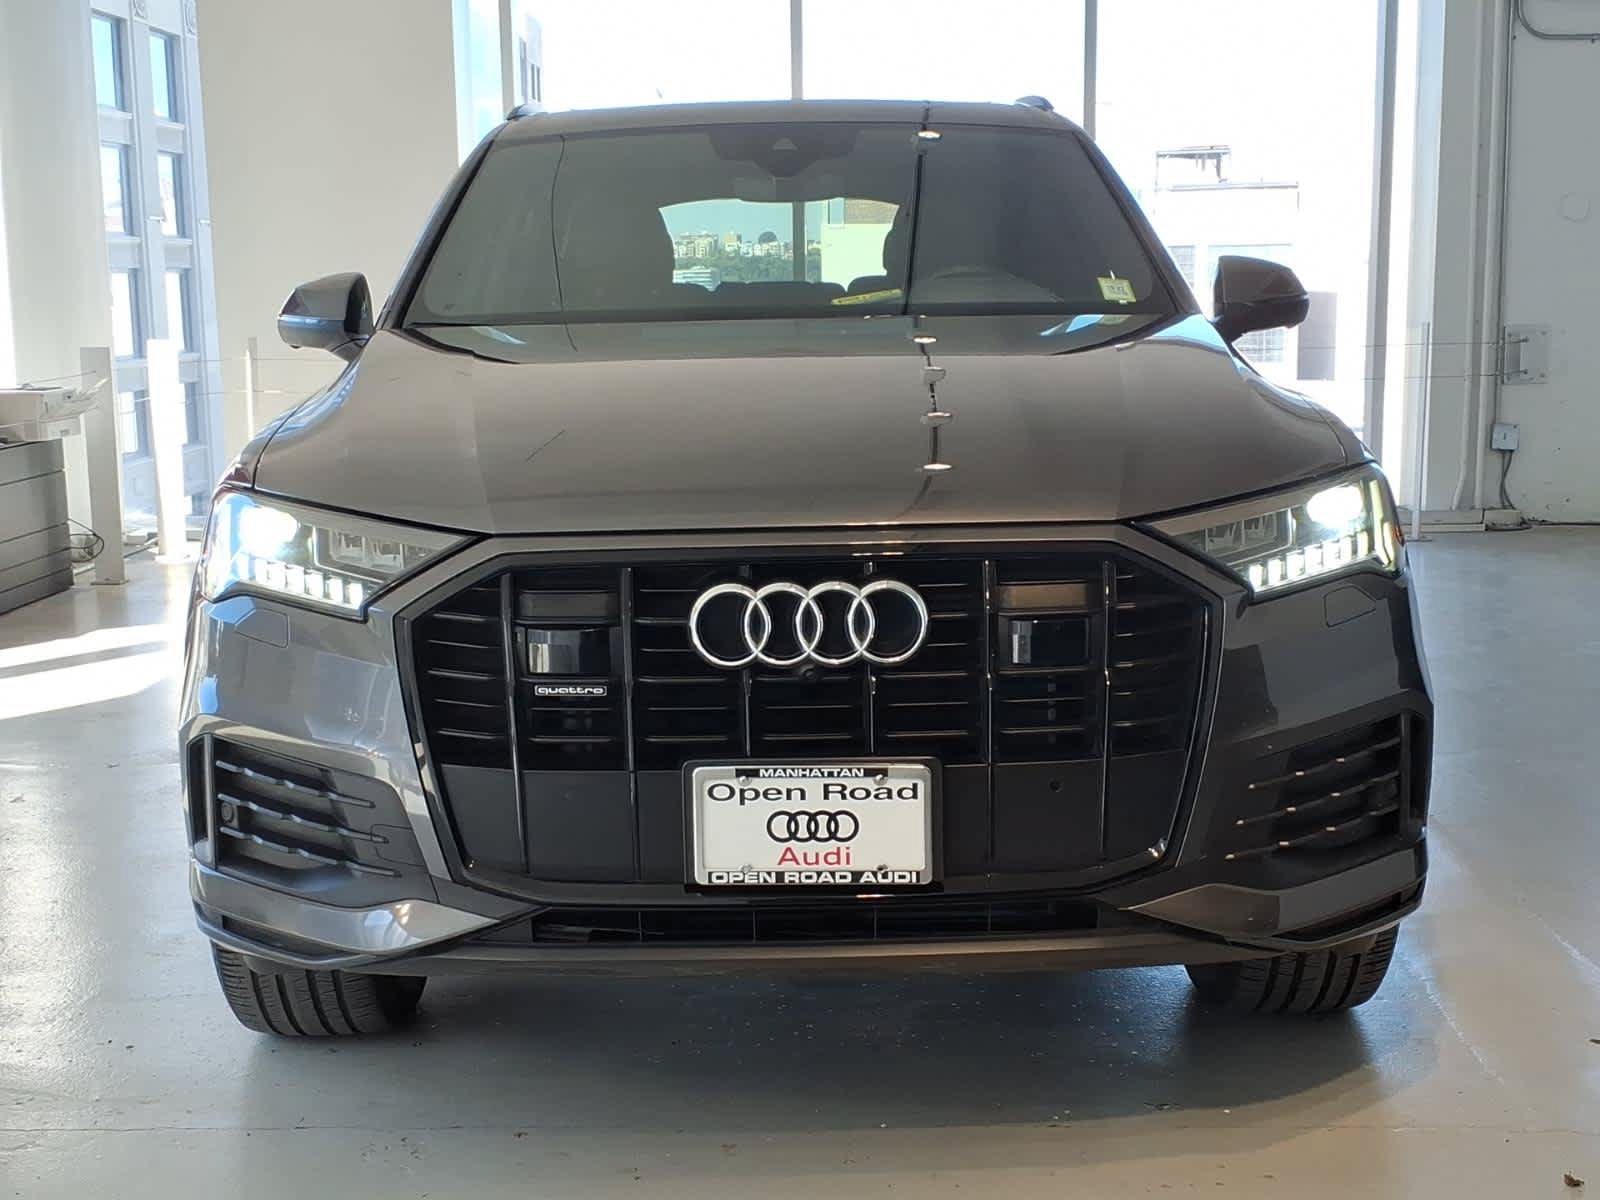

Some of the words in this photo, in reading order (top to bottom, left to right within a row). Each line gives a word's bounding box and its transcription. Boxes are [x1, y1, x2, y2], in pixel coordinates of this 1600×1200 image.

[538, 687, 604, 696] quattro
[759, 768, 864, 777] MANHATTAN
[707, 783, 807, 805] Open
[823, 782, 919, 801] Road
[777, 846, 851, 866] Audi
[711, 871, 777, 884] OPEN
[784, 871, 852, 883] ROAD
[860, 871, 917, 883] AUDI
